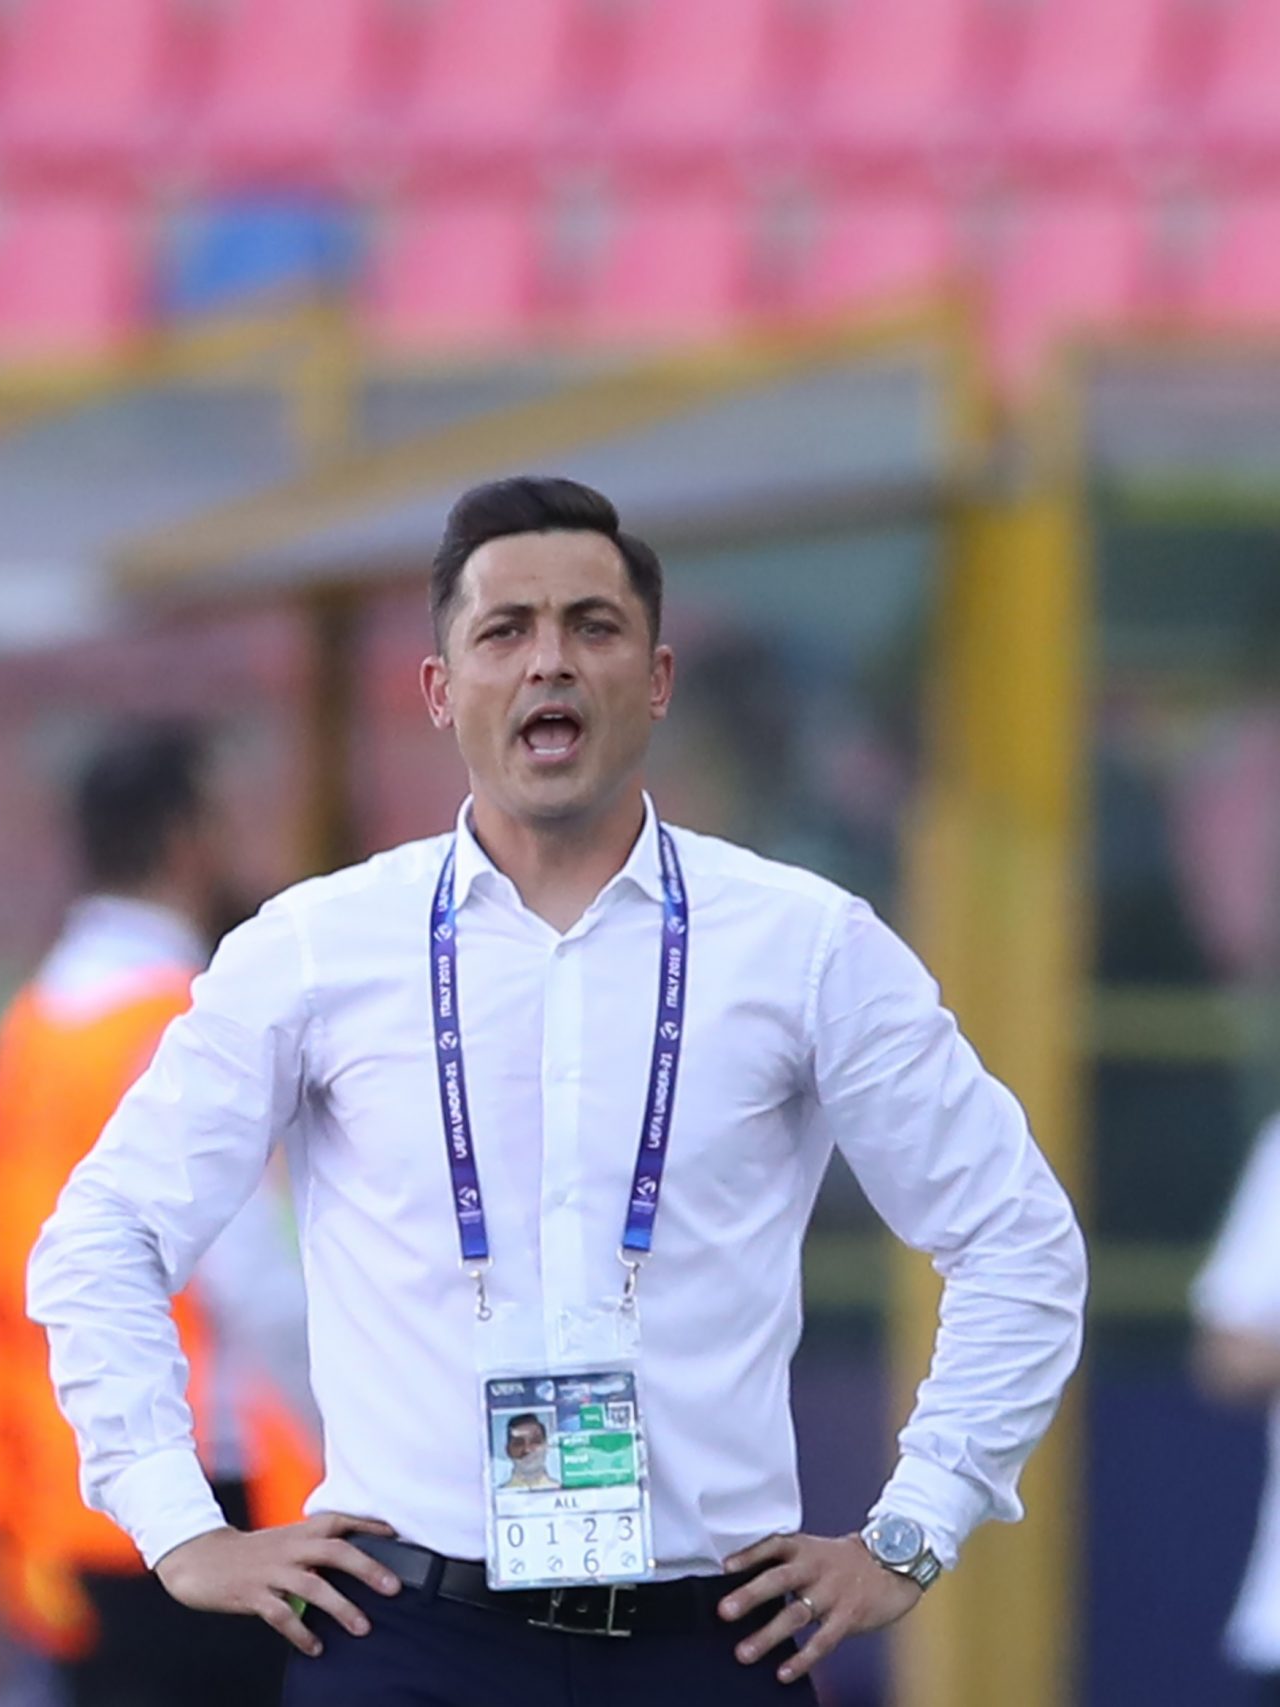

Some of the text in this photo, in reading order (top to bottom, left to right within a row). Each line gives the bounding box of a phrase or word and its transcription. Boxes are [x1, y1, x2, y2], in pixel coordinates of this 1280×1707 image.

[437, 955, 452, 1018] ITALY 2019
[666, 947, 681, 1008] ITALY 2019
[445, 1061, 467, 1158] UEFA UNDER-21
[648, 1053, 672, 1148] UEFA UNDER-21
[546, 1522, 560, 1545] 1
[583, 1518, 599, 1543] 2
[618, 1515, 634, 1541] 3
[554, 1496, 581, 1509] ALL
[583, 1548, 600, 1574] 6
